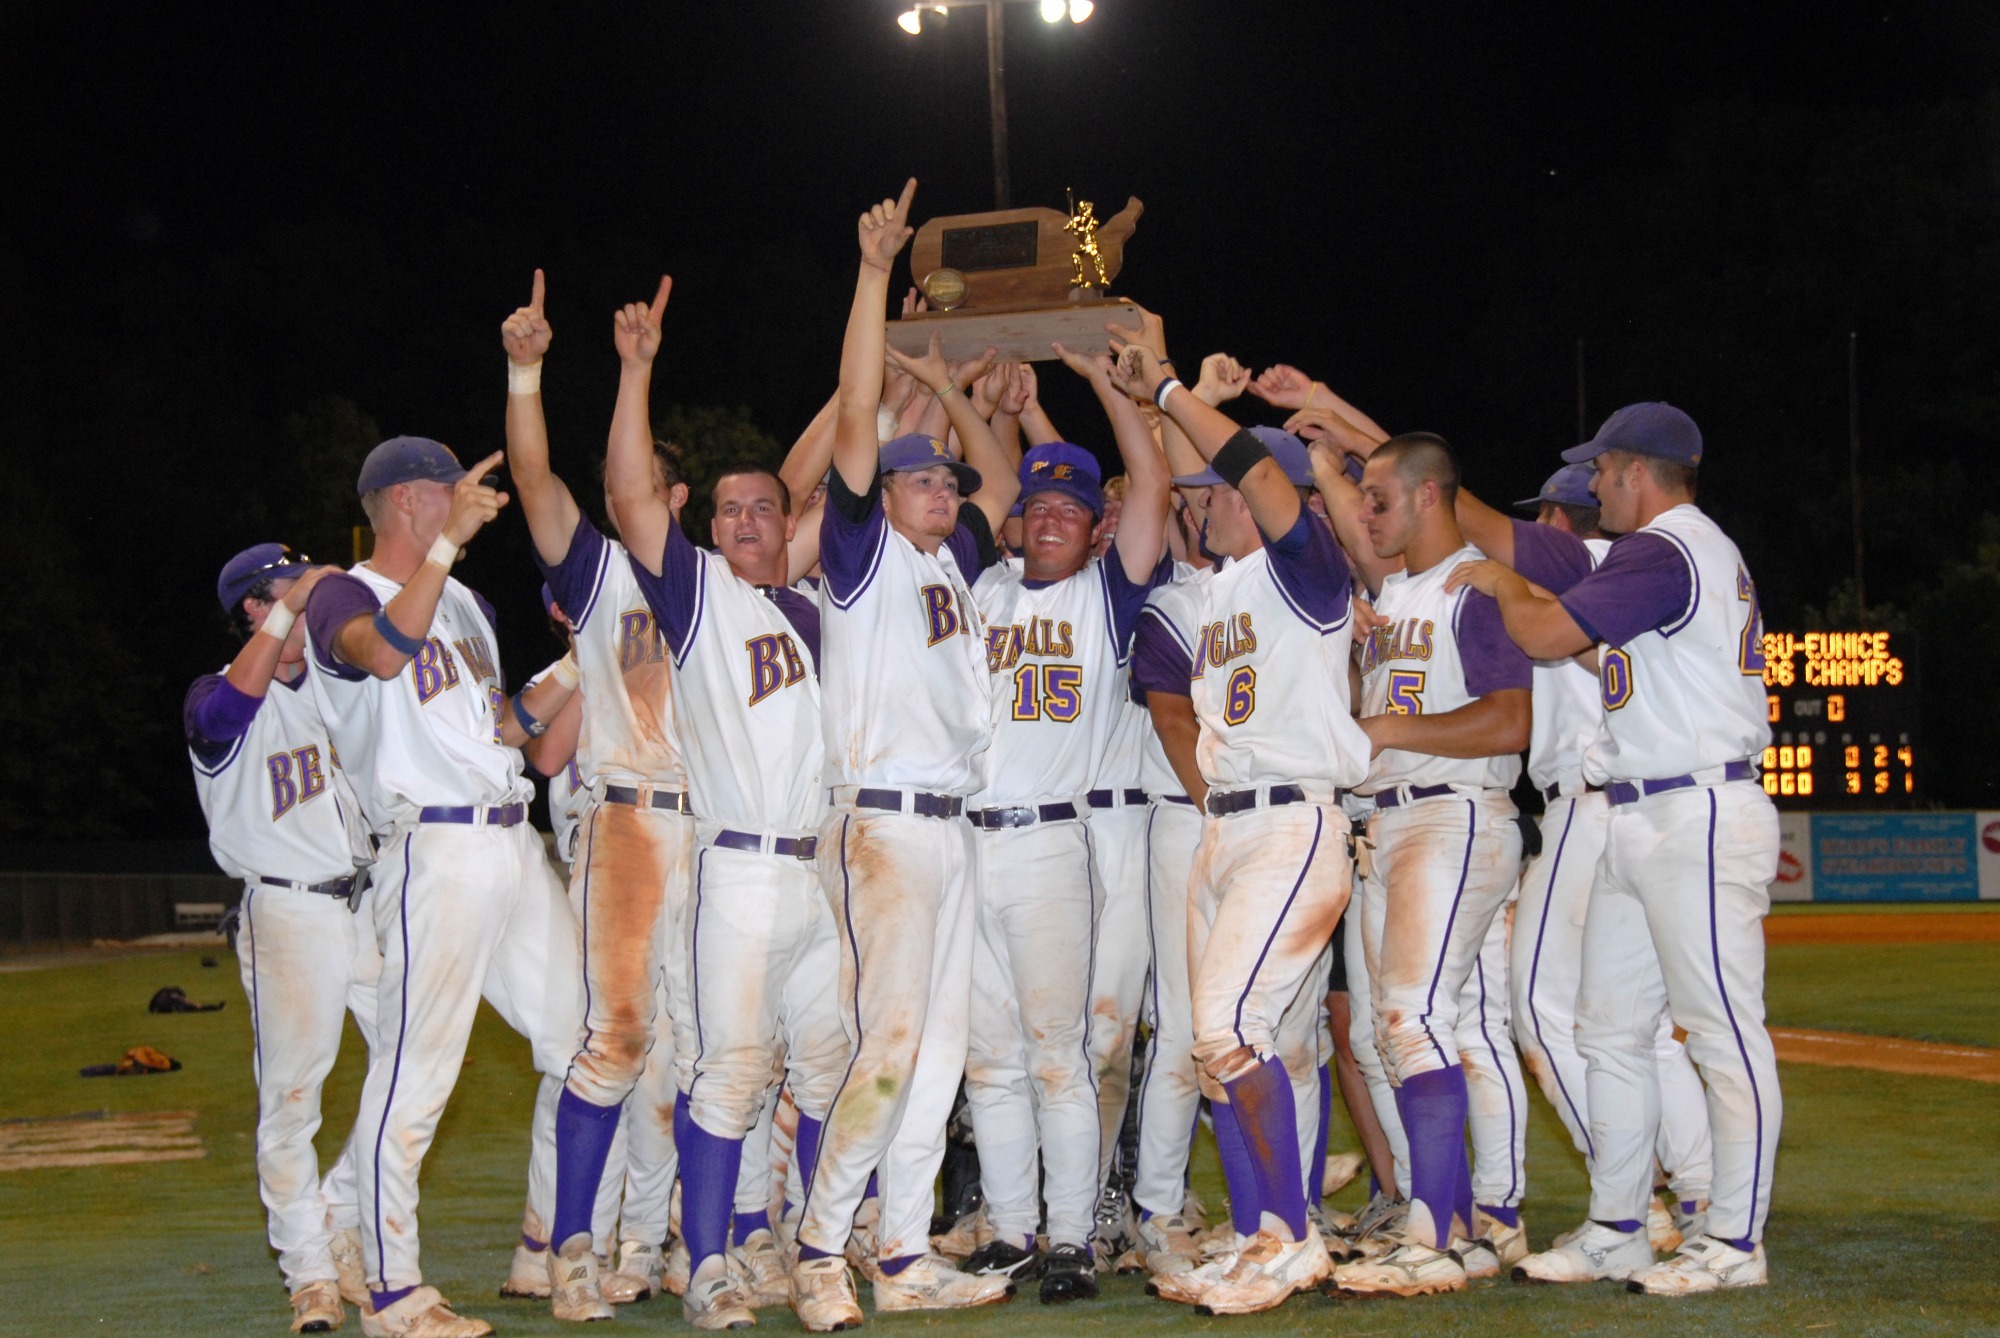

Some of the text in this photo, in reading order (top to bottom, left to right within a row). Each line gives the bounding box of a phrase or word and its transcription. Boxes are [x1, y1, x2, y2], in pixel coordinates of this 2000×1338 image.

[1012, 663, 1083, 723] 15
[1223, 664, 1257, 727] 6
[1804, 658, 1904, 687] CHAMPS
